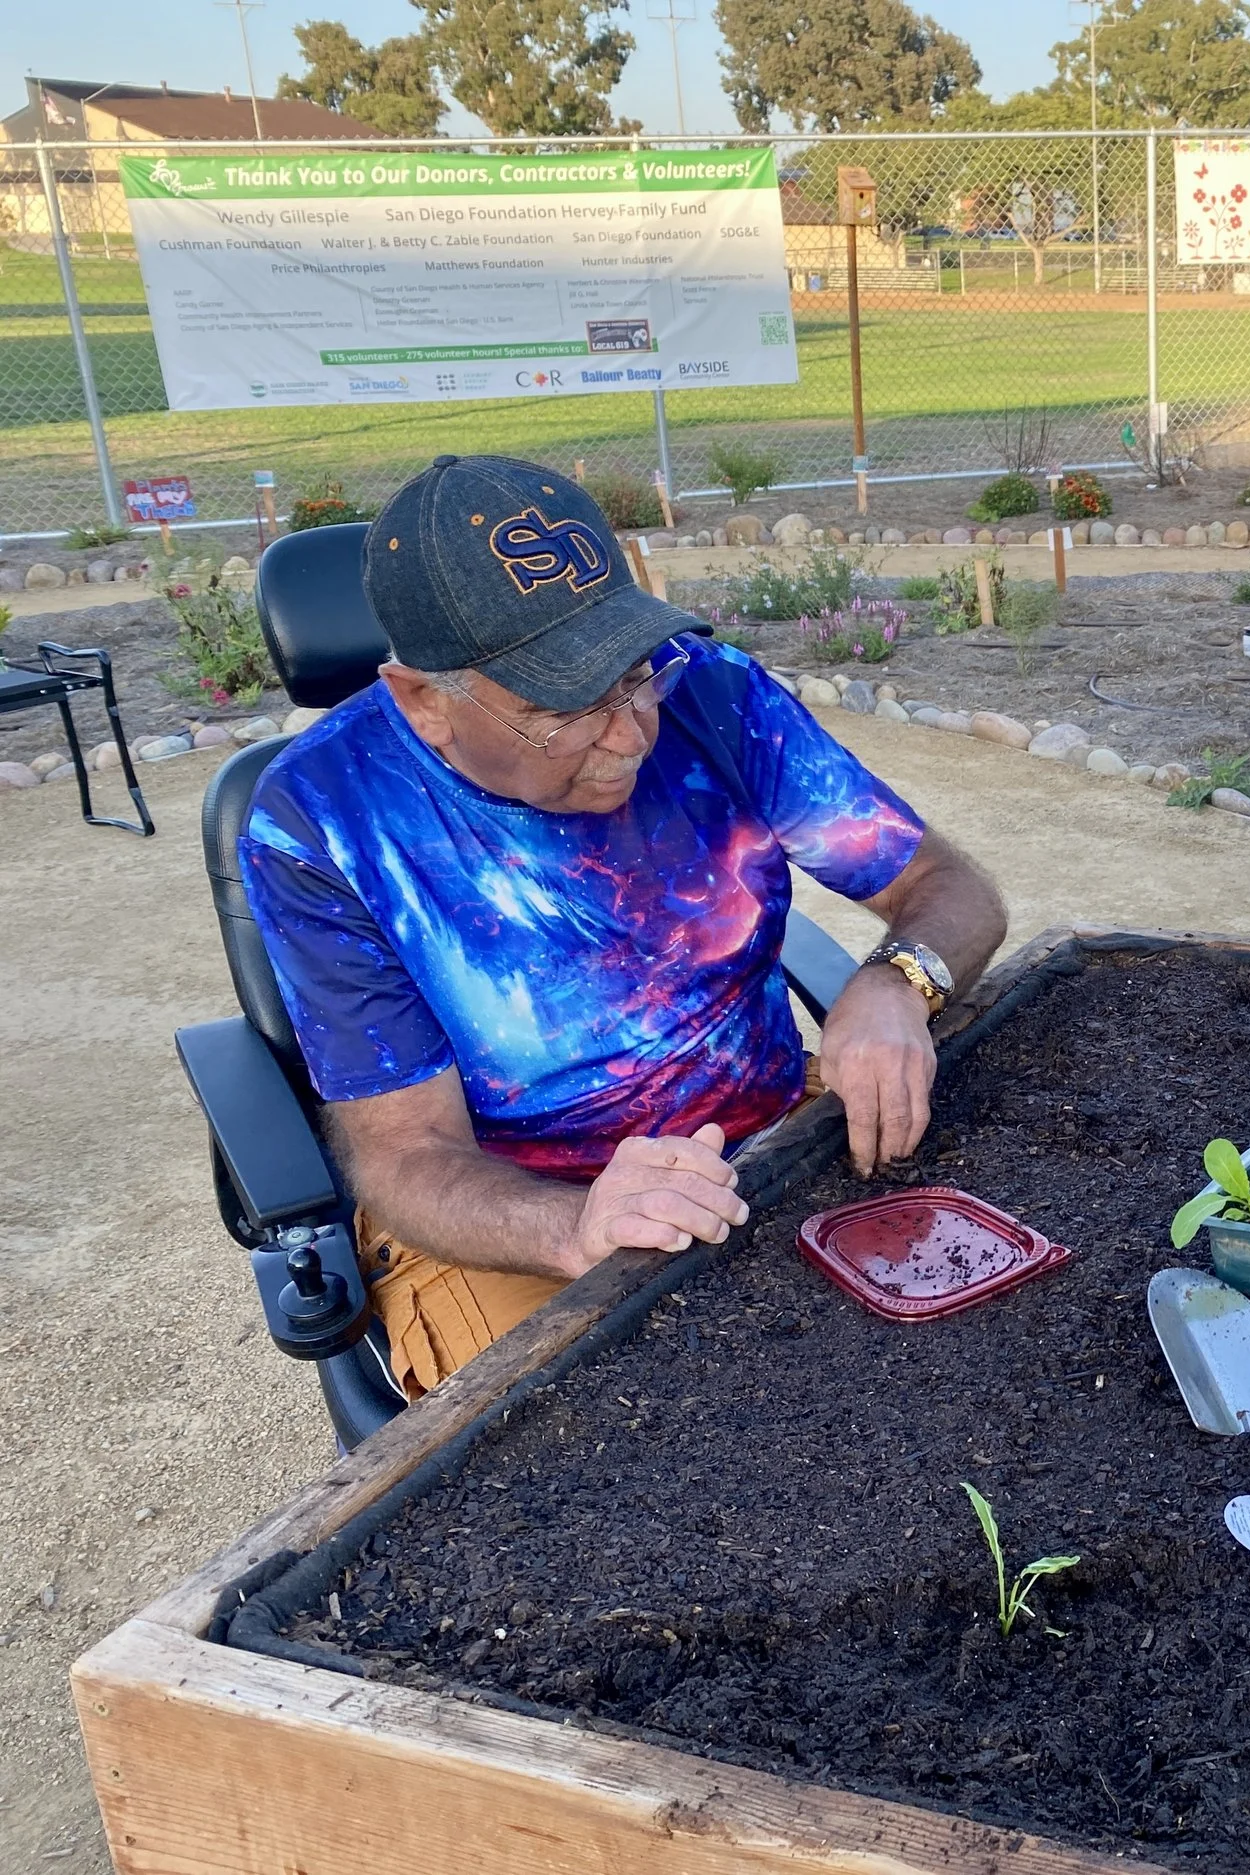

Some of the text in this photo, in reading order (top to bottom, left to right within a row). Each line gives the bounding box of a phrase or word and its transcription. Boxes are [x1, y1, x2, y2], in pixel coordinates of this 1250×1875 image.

[224, 160, 751, 186] Thank You to Our Donors, Contractors & Volunteers!
[217, 209, 349, 228] Wendy Gillespie
[385, 202, 707, 224] San Diego Foundation Hervey Family Fund
[573, 229, 702, 245] San Diego Foundation
[720, 226, 760, 239] SDG&E
[159, 238, 302, 251] Cushman Foundation
[321, 232, 554, 250] Walter J. & Betty C. Zable Foundation
[425, 257, 544, 272] Matthews Foundation
[582, 253, 673, 267] Hunter Industries
[271, 261, 386, 275] Price Philanthropies
[592, 341, 616, 350] LOCAL
[327, 352, 345, 363] 315
[346, 351, 399, 362] volunteers
[406, 350, 423, 360] 275
[425, 349, 470, 359] volunteer
[472, 347, 502, 357] hours!
[504, 346, 536, 357] Special
[538, 344, 569, 354] thanks
[627, 368, 662, 382] Beatty
[678, 360, 730, 375] BAYSIDE
[349, 380, 404, 391] SAN DIEGO
[490, 507, 610, 595] SD
